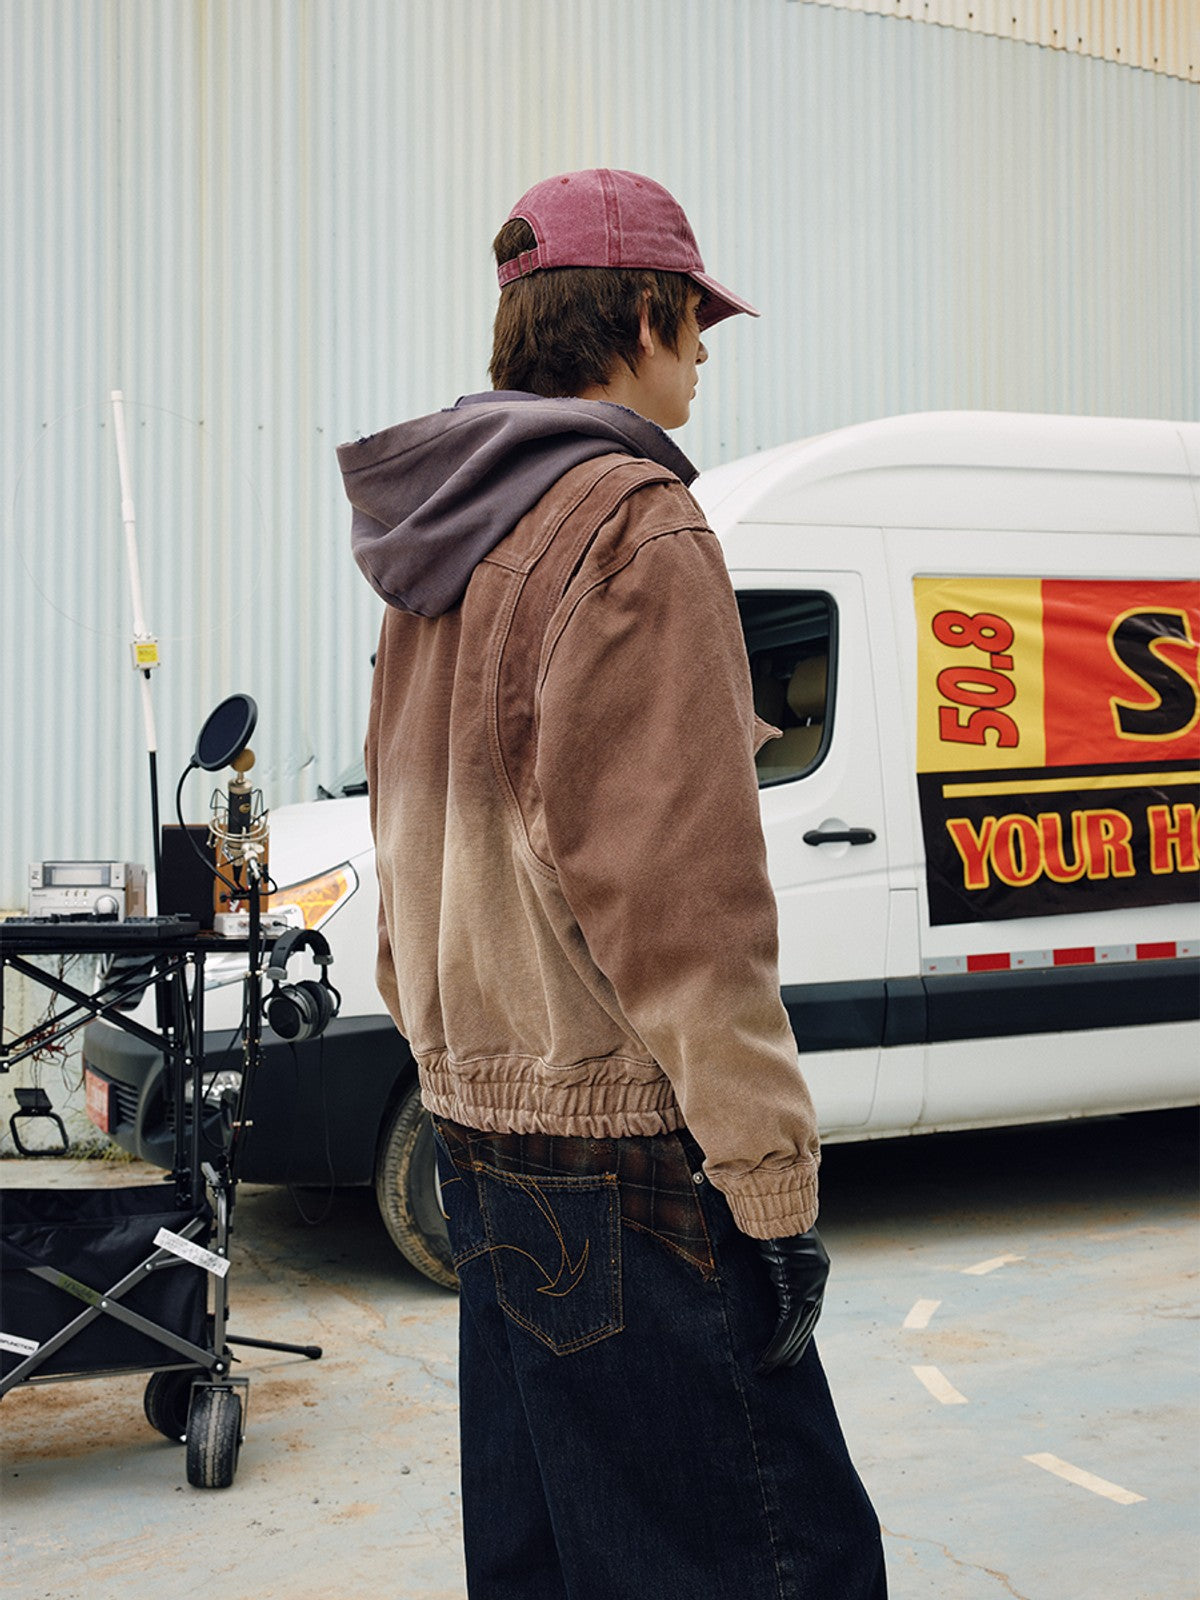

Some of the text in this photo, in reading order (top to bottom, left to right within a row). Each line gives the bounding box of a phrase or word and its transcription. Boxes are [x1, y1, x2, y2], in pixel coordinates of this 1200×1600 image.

[932, 610, 1019, 748] 50.8
[1106, 605, 1200, 742] S
[946, 803, 1200, 890] YOUR H
